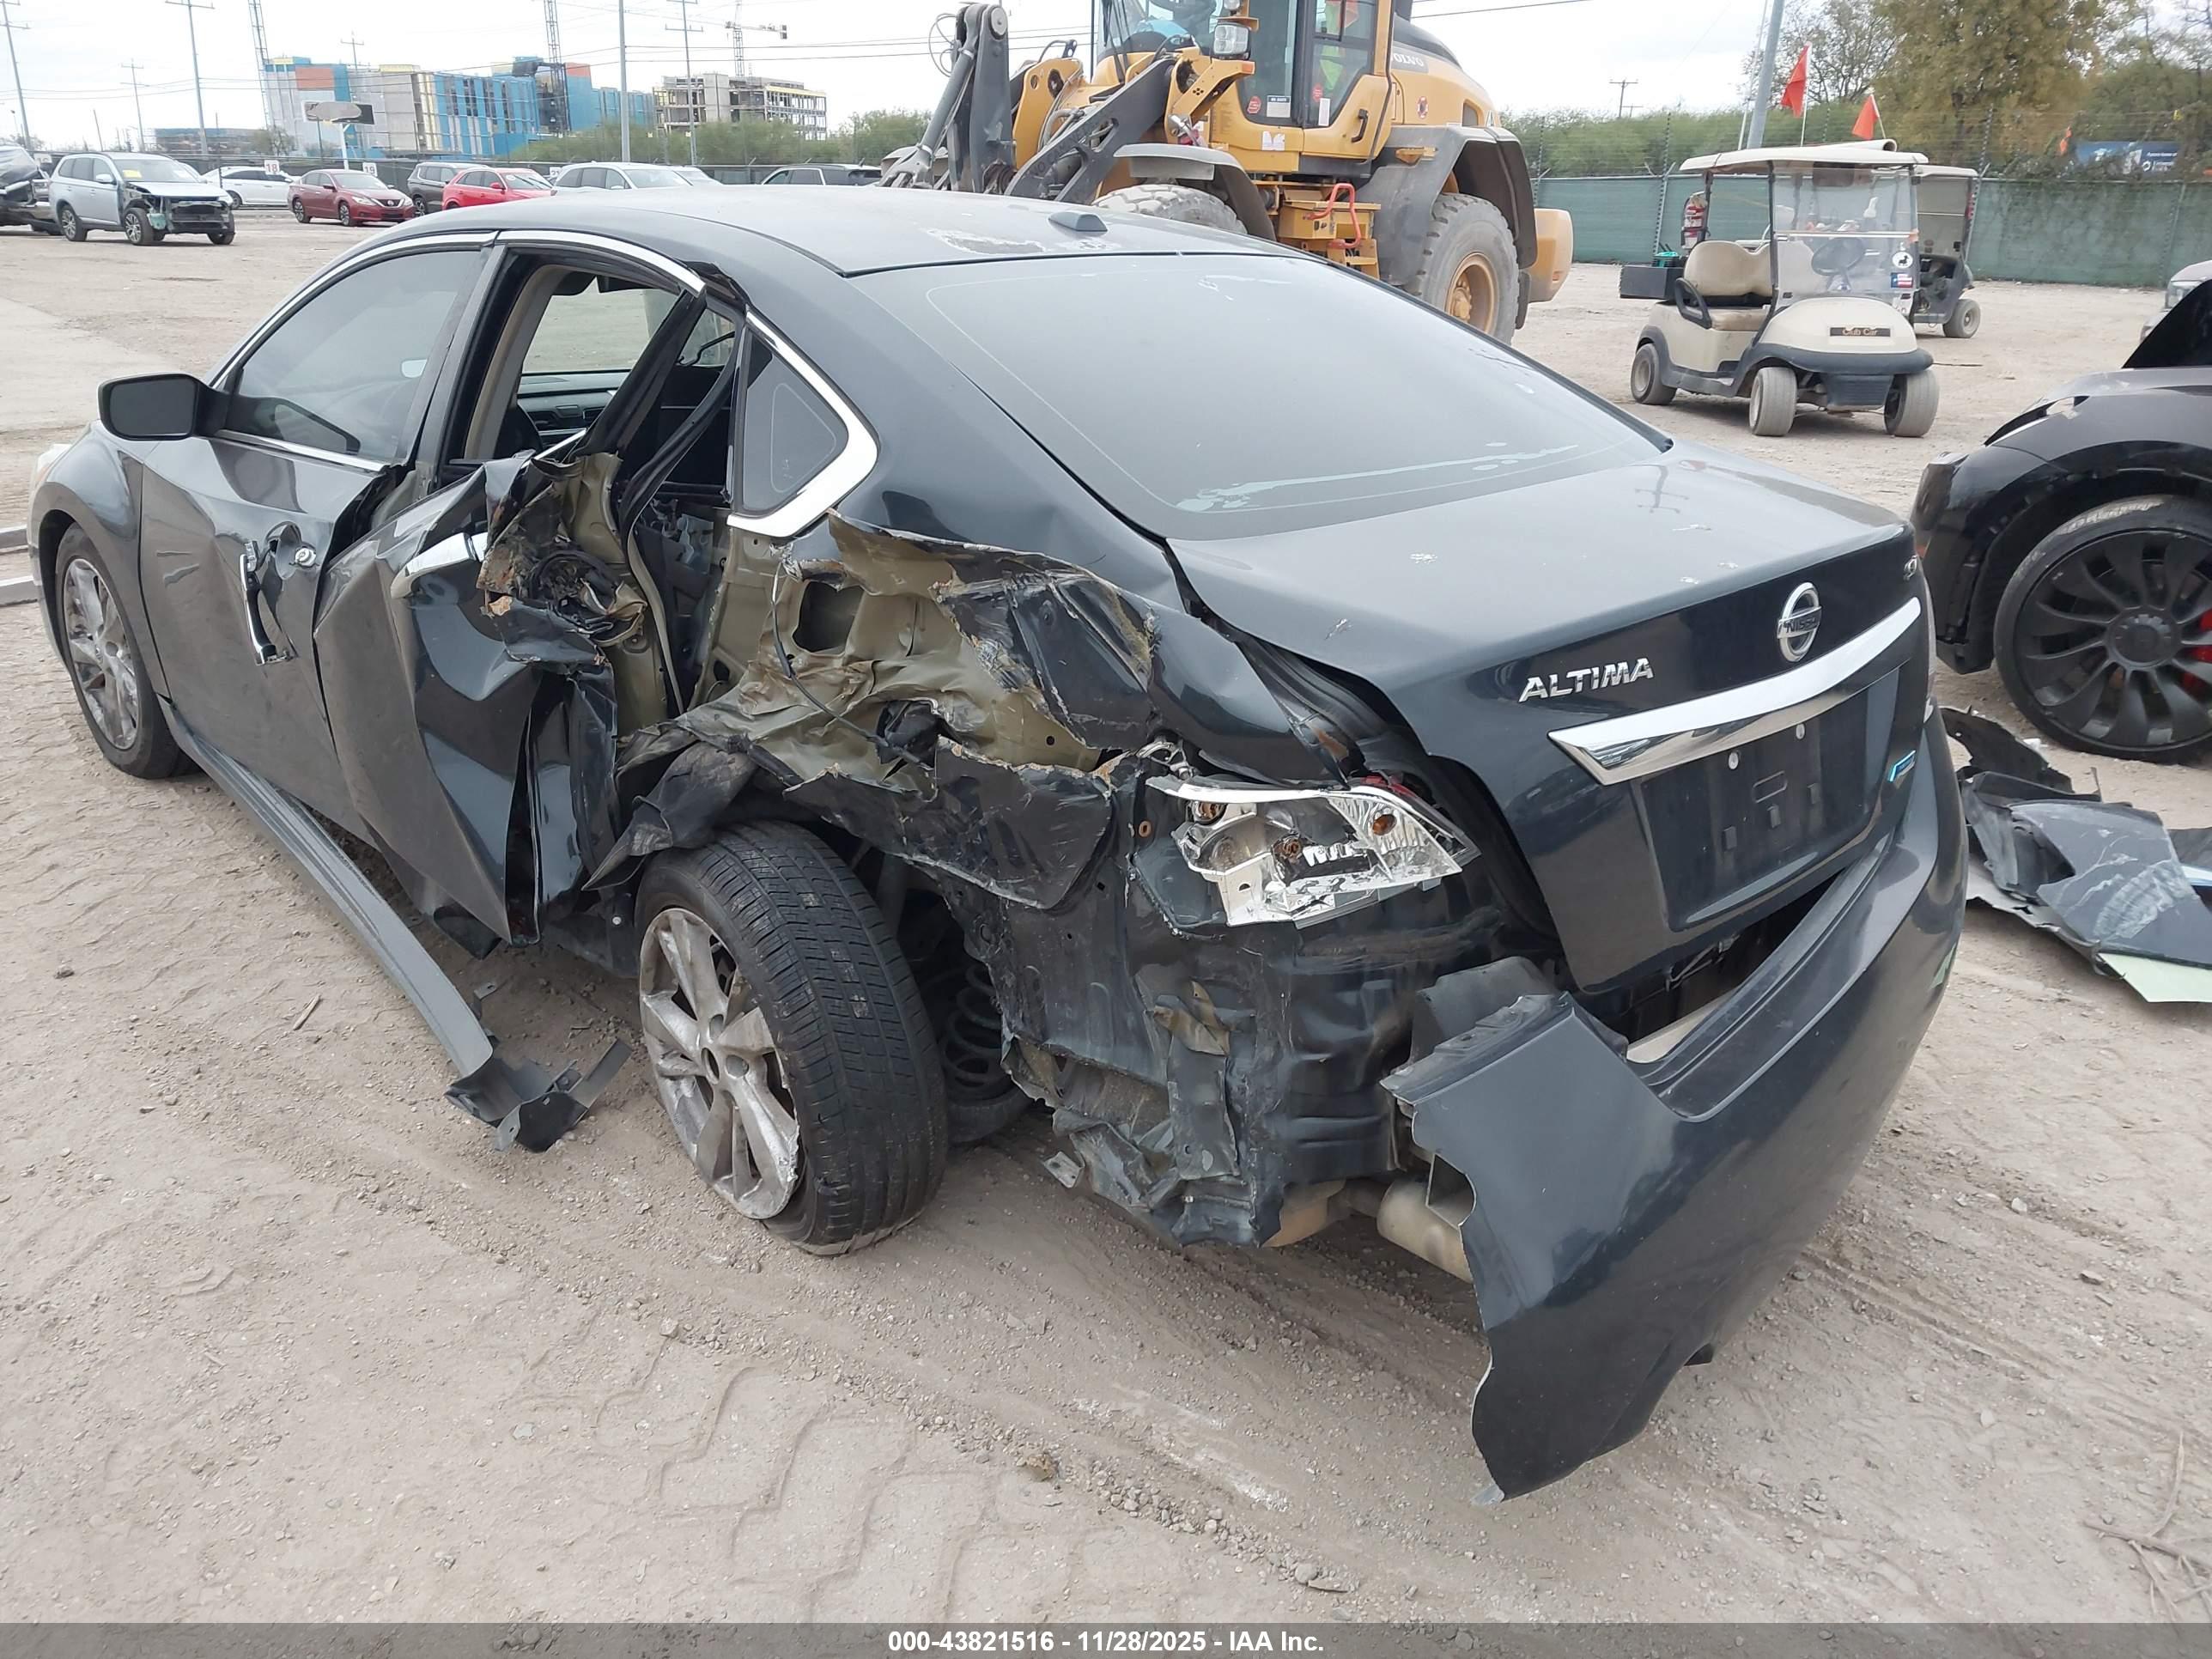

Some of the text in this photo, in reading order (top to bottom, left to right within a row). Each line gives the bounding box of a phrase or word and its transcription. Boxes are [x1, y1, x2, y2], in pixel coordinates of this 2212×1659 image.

[1392, 52, 1425, 67] OLVO
[265, 162, 278, 173] 18
[1518, 657, 1654, 703] ALTIMA
